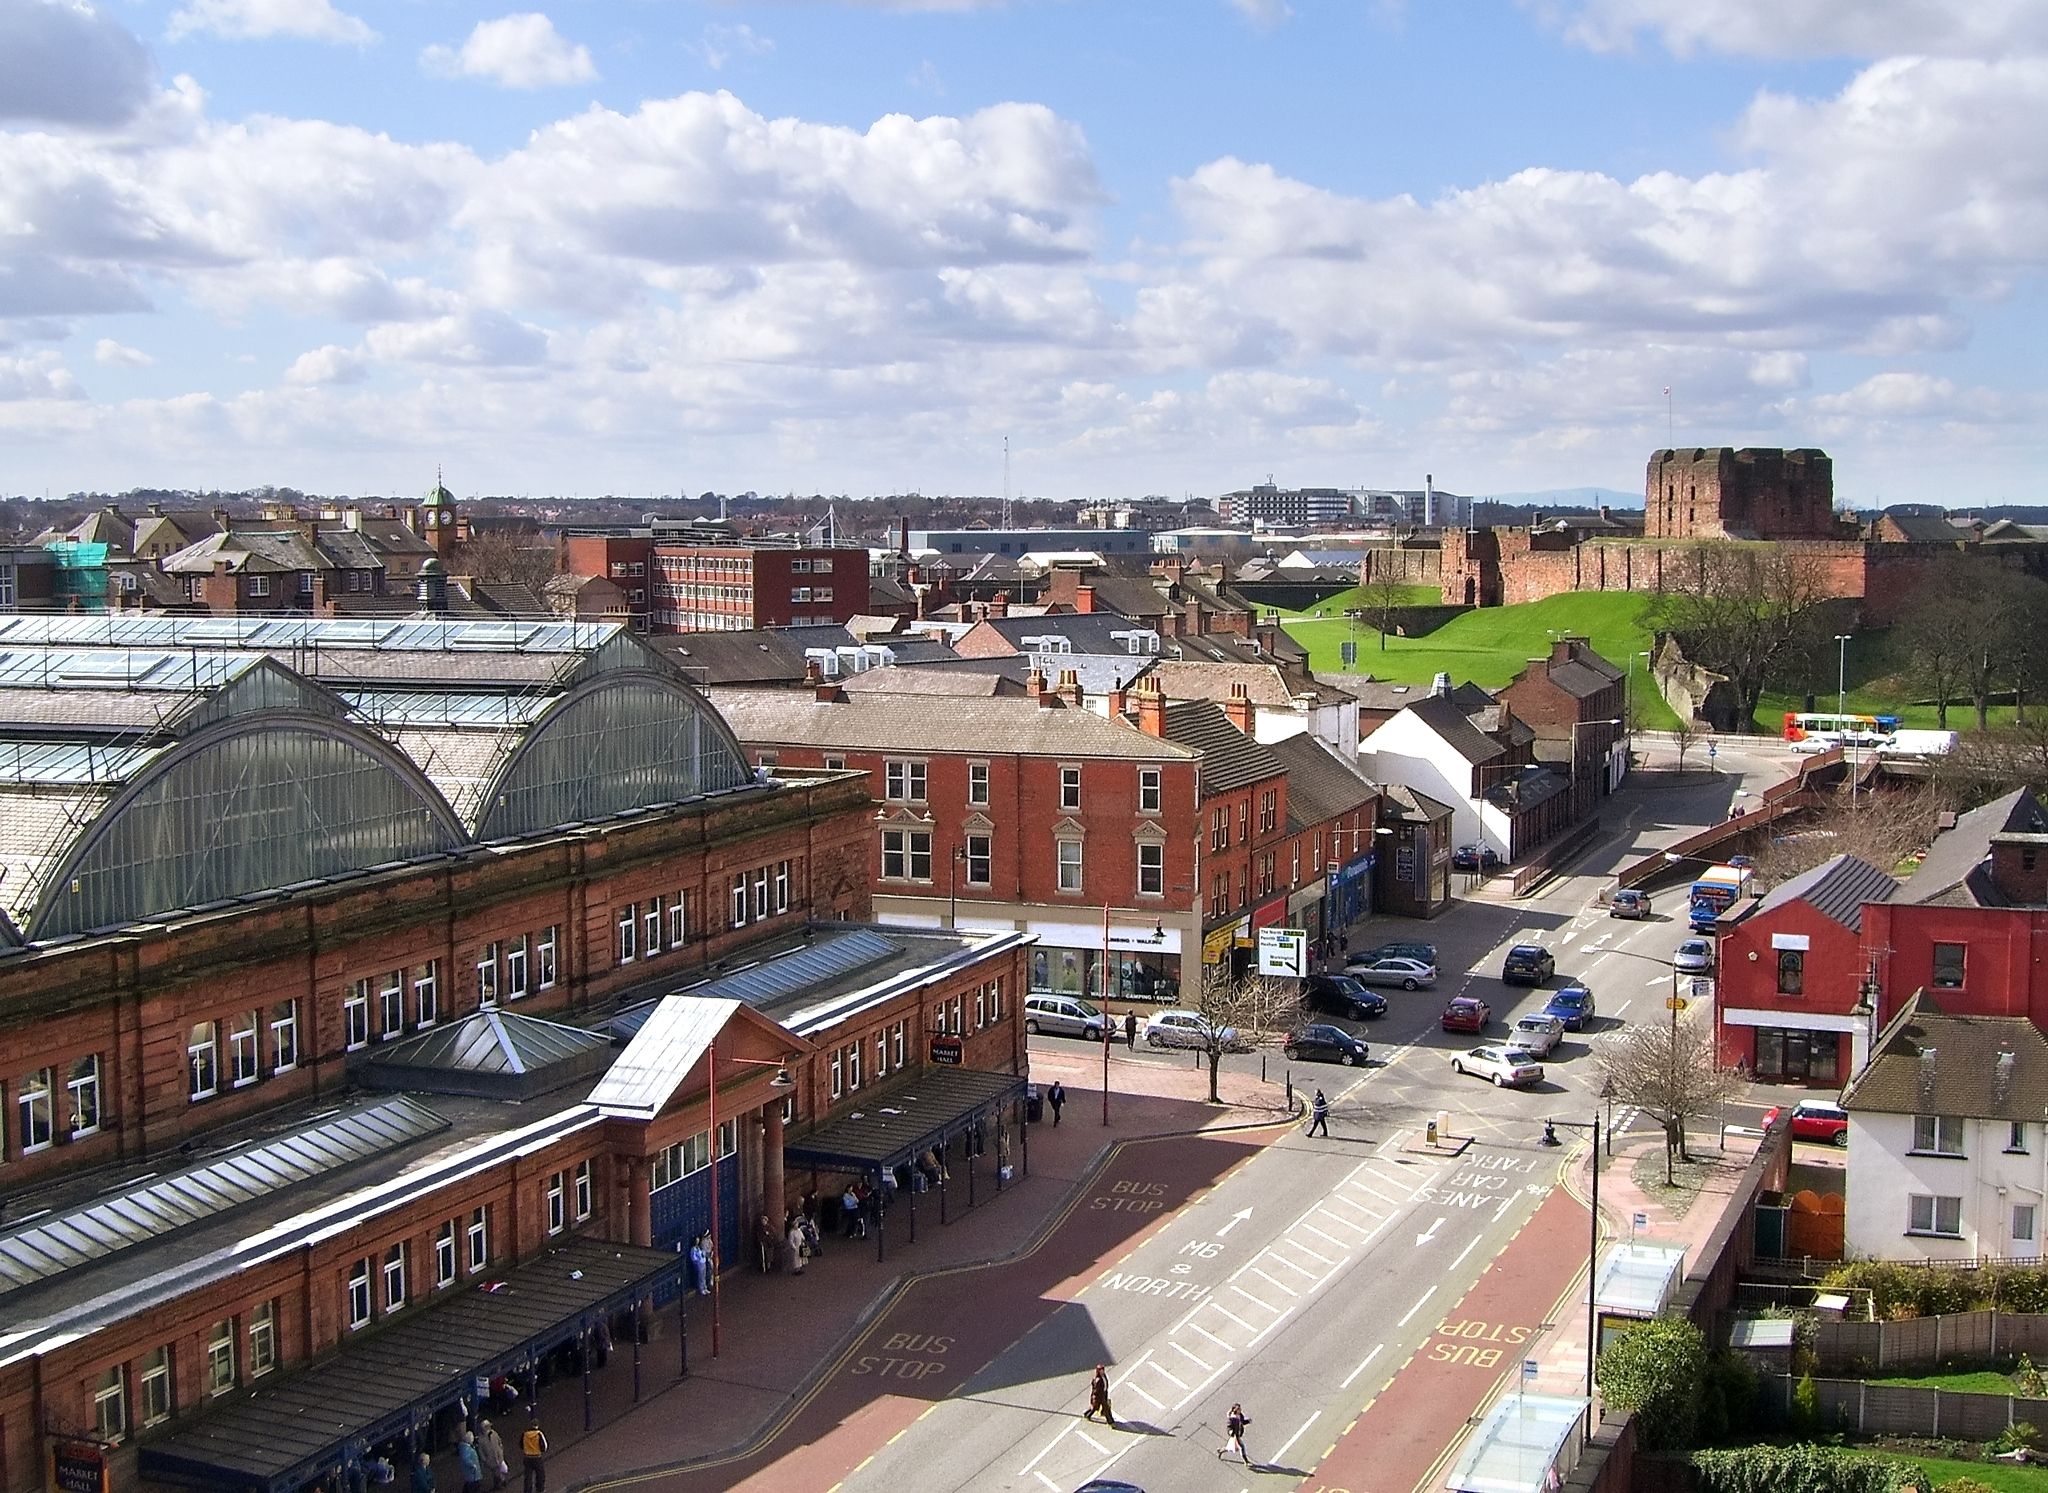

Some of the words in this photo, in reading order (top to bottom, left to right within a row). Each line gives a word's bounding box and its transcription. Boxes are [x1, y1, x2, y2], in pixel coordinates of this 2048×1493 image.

[1463, 1153, 1537, 1173] PARK
[1111, 1180, 1169, 1196] BUS
[1450, 1171, 1508, 1190] CAR
[1090, 1197, 1165, 1213] STOP
[1411, 1187, 1509, 1211] LANES
[1178, 1240, 1225, 1259] M6
[1168, 1263, 1192, 1274] &
[1103, 1272, 1213, 1301] NORTH
[1438, 1319, 1532, 1344] STOP
[882, 1332, 956, 1354] BUS
[1428, 1343, 1504, 1369] BUS
[851, 1356, 945, 1380] STOP
[59, 1466, 98, 1481] MARKET
[65, 1479, 92, 1492] HALL
